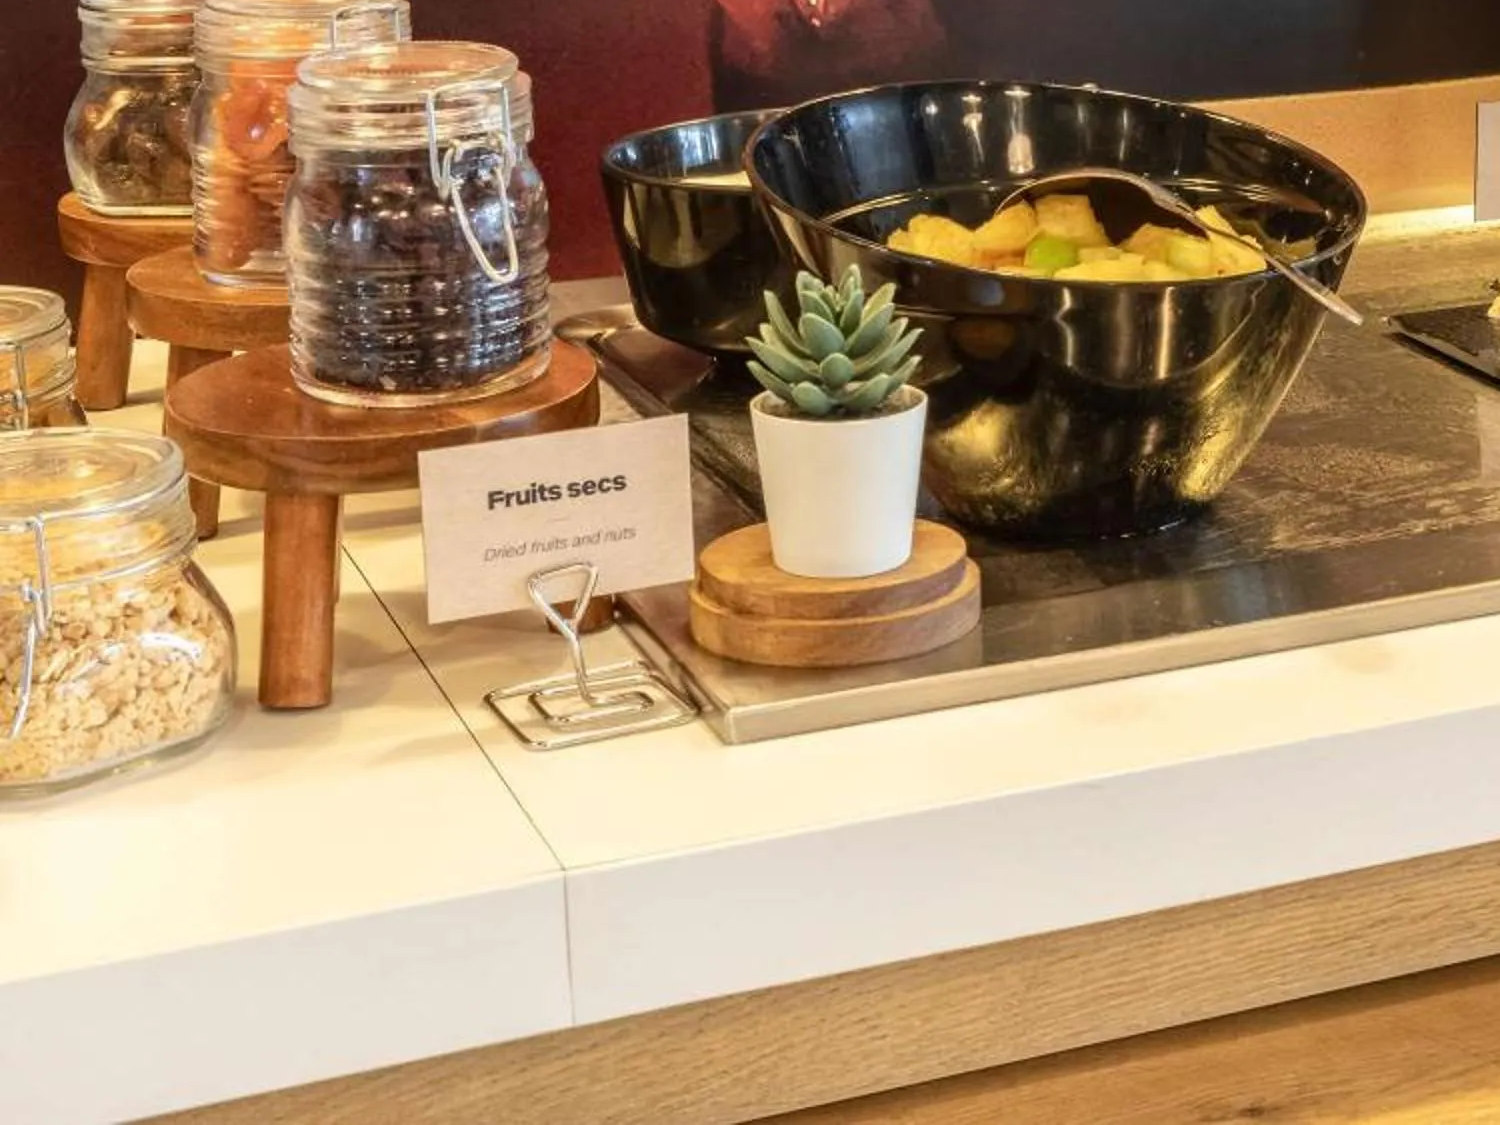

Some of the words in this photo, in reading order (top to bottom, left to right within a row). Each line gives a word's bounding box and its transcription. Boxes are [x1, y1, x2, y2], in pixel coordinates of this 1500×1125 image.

[487, 483, 562, 511] Fruits
[567, 474, 627, 499] secs
[484, 541, 527, 563] Dried
[530, 536, 568, 553] fruits
[572, 532, 601, 547] and
[604, 526, 637, 542] nuts
